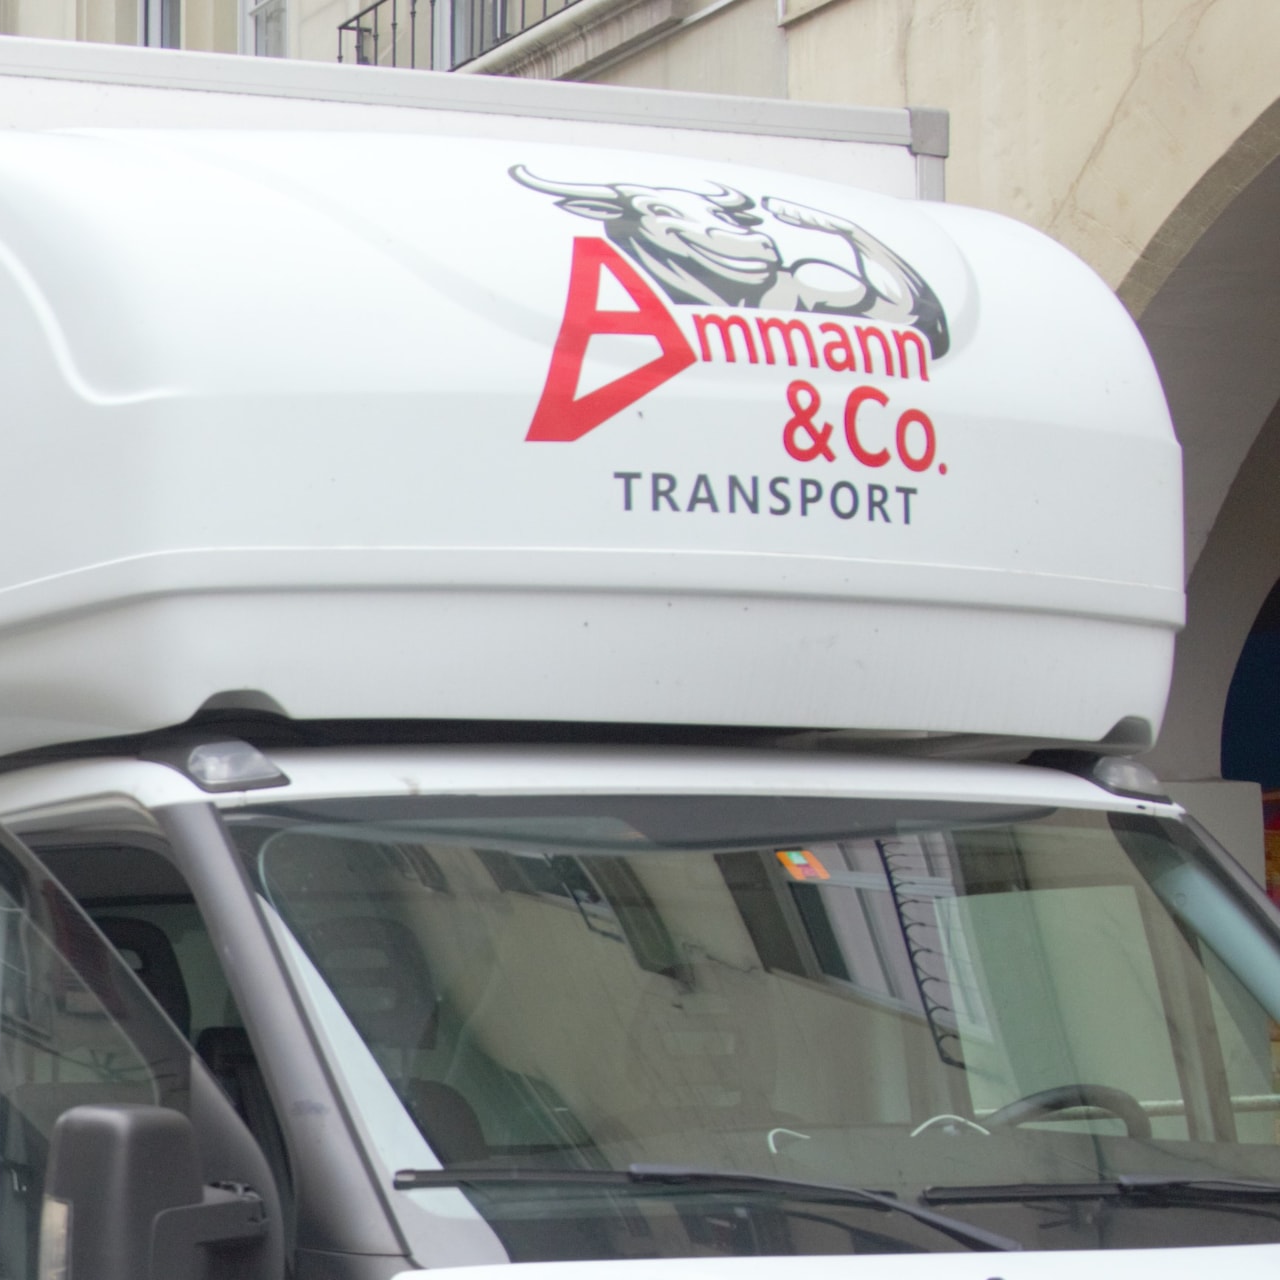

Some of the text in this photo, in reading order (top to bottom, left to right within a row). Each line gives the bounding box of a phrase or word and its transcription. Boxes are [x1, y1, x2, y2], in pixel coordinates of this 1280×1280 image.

[524, 236, 930, 441] Ammann
[782, 379, 948, 475] &Co.
[613, 471, 918, 525] TRANSPORT
